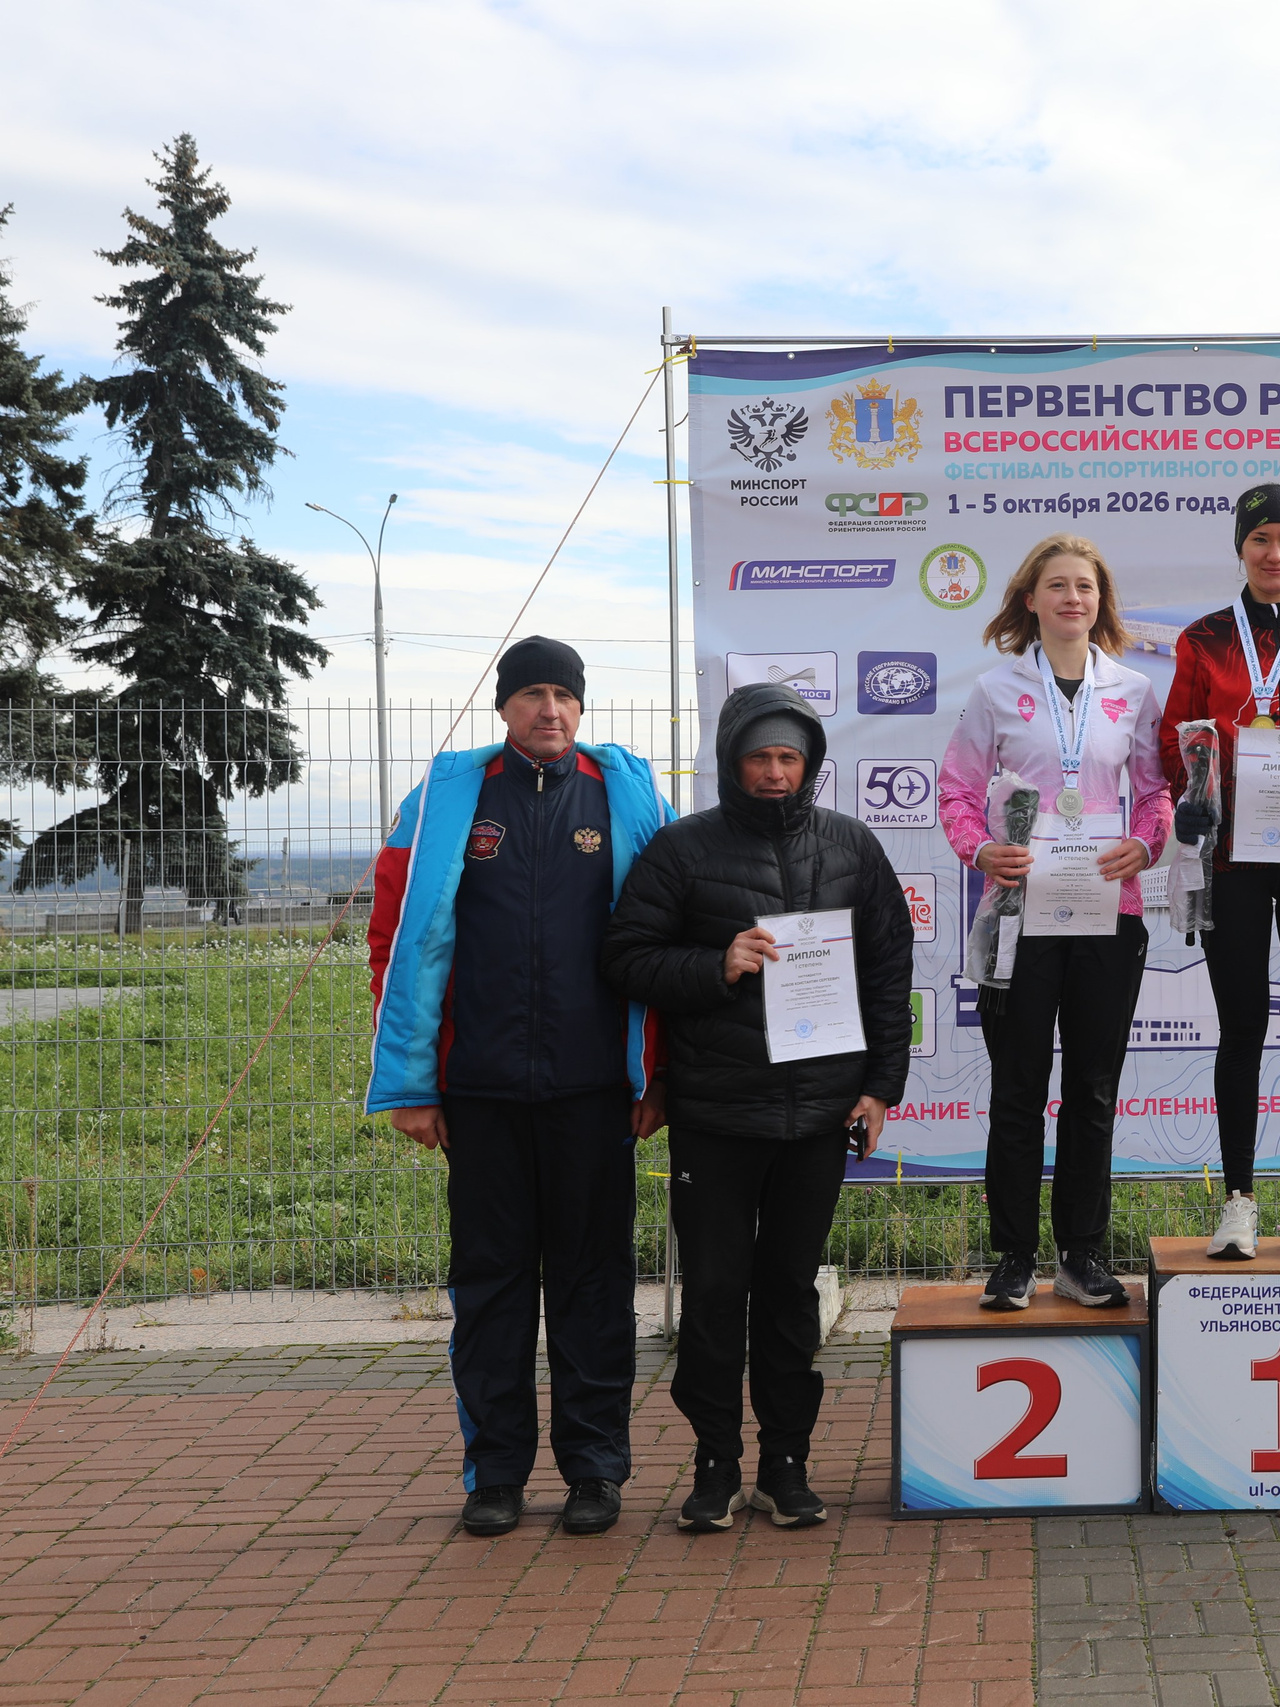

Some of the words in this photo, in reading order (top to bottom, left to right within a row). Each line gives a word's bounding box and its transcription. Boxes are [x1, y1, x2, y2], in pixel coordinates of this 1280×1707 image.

[945, 383, 1247, 419] ПЕРВЕНСТВО
[944, 425, 1198, 453] ВСЕРОССИЙСКИЕ
[944, 461, 1074, 481] ФЕСТИВАЛЬ
[1078, 459, 1239, 479] СПОРТИВНОГО
[730, 478, 807, 491] МИНСПОРТ
[740, 495, 798, 507] РОССИИ
[948, 493, 960, 514] 1
[983, 492, 997, 514] 5
[1002, 492, 1102, 518] октября
[1106, 491, 1170, 513] 2026
[751, 564, 889, 579] МИНСПОРТ
[866, 814, 928, 823] АВИАСТАР
[1050, 845, 1098, 854] ДИПЛОМ
[787, 948, 831, 962] ДИПЛОМ
[886, 1101, 970, 1121] ВАНИЕ
[973, 1356, 1068, 1480] 2
